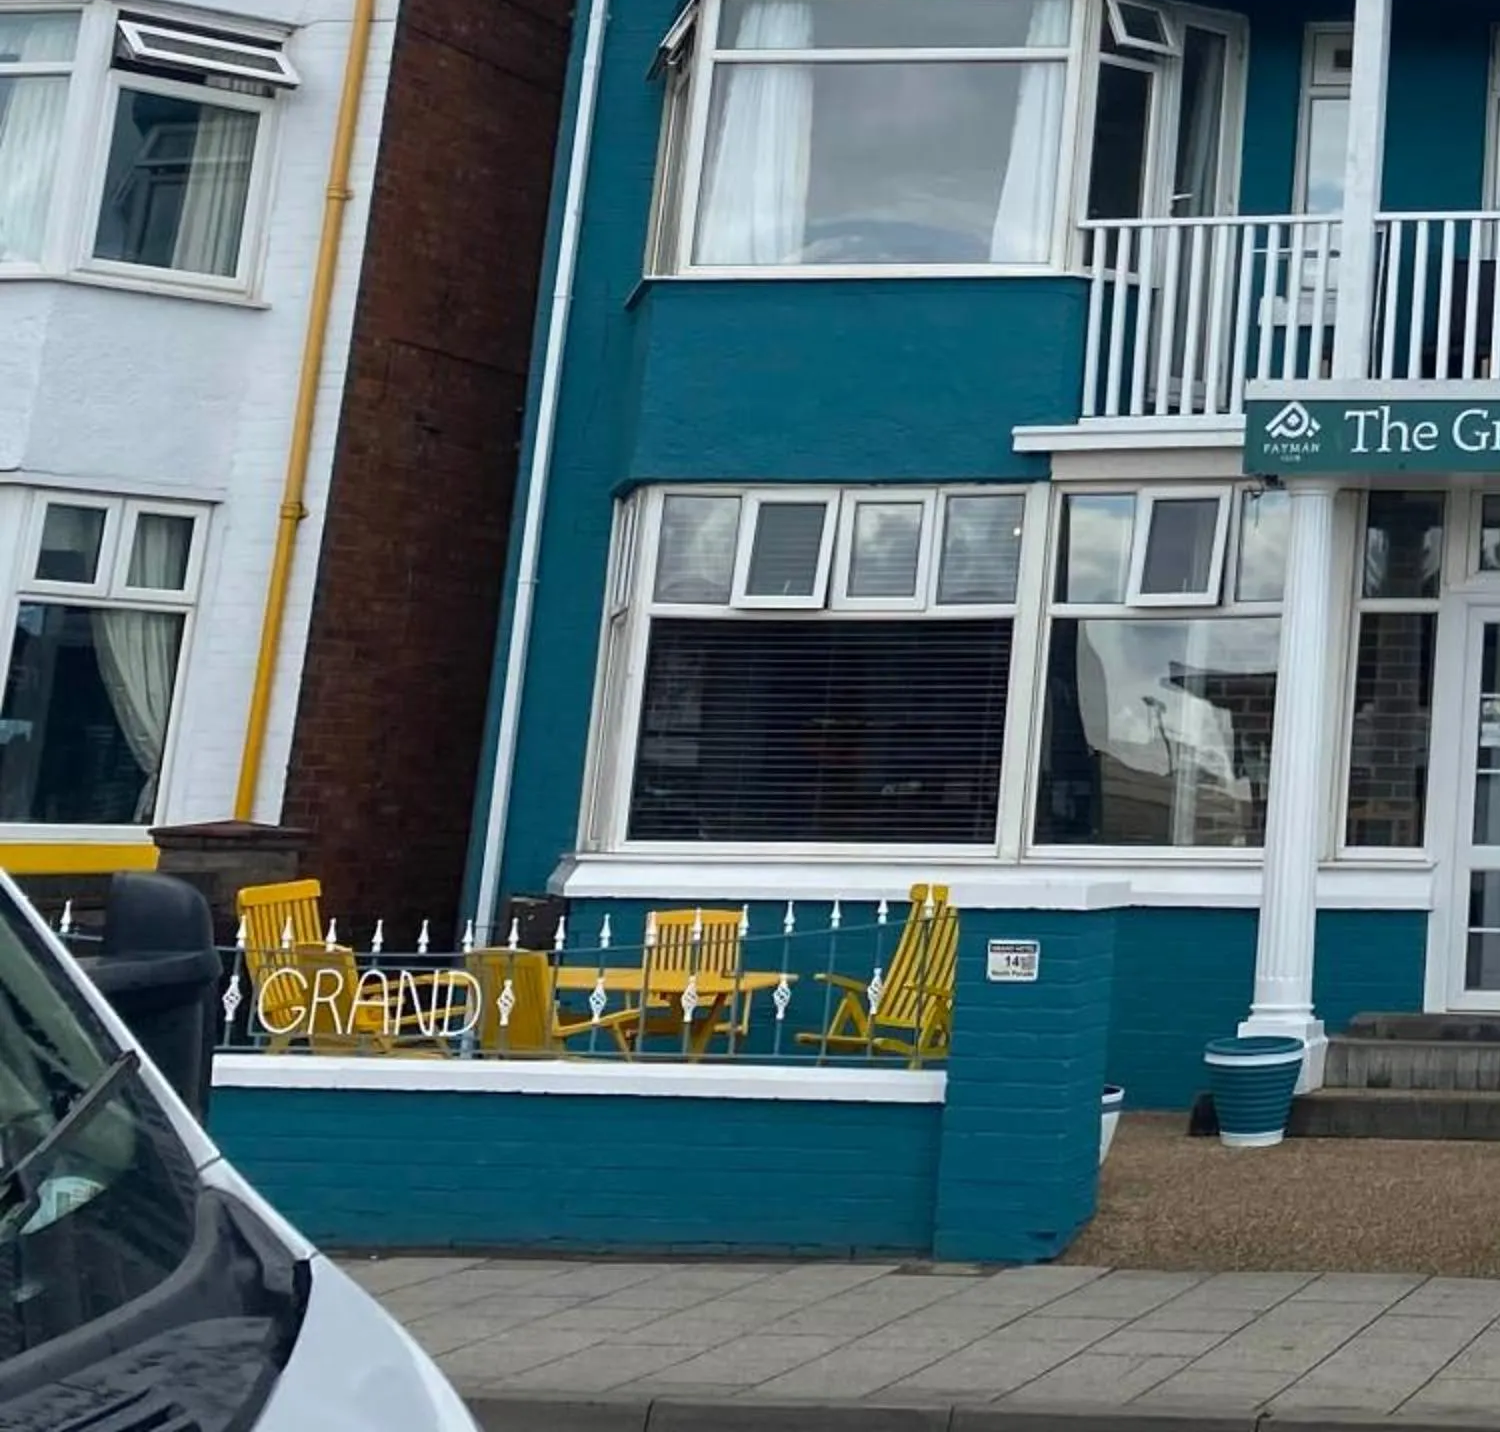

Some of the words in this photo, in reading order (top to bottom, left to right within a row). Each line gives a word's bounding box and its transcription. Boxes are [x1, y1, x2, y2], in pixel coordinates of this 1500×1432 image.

[1344, 405, 1439, 453] The
[1005, 955, 1019, 967] 14
[258, 968, 482, 1036] GRAND
